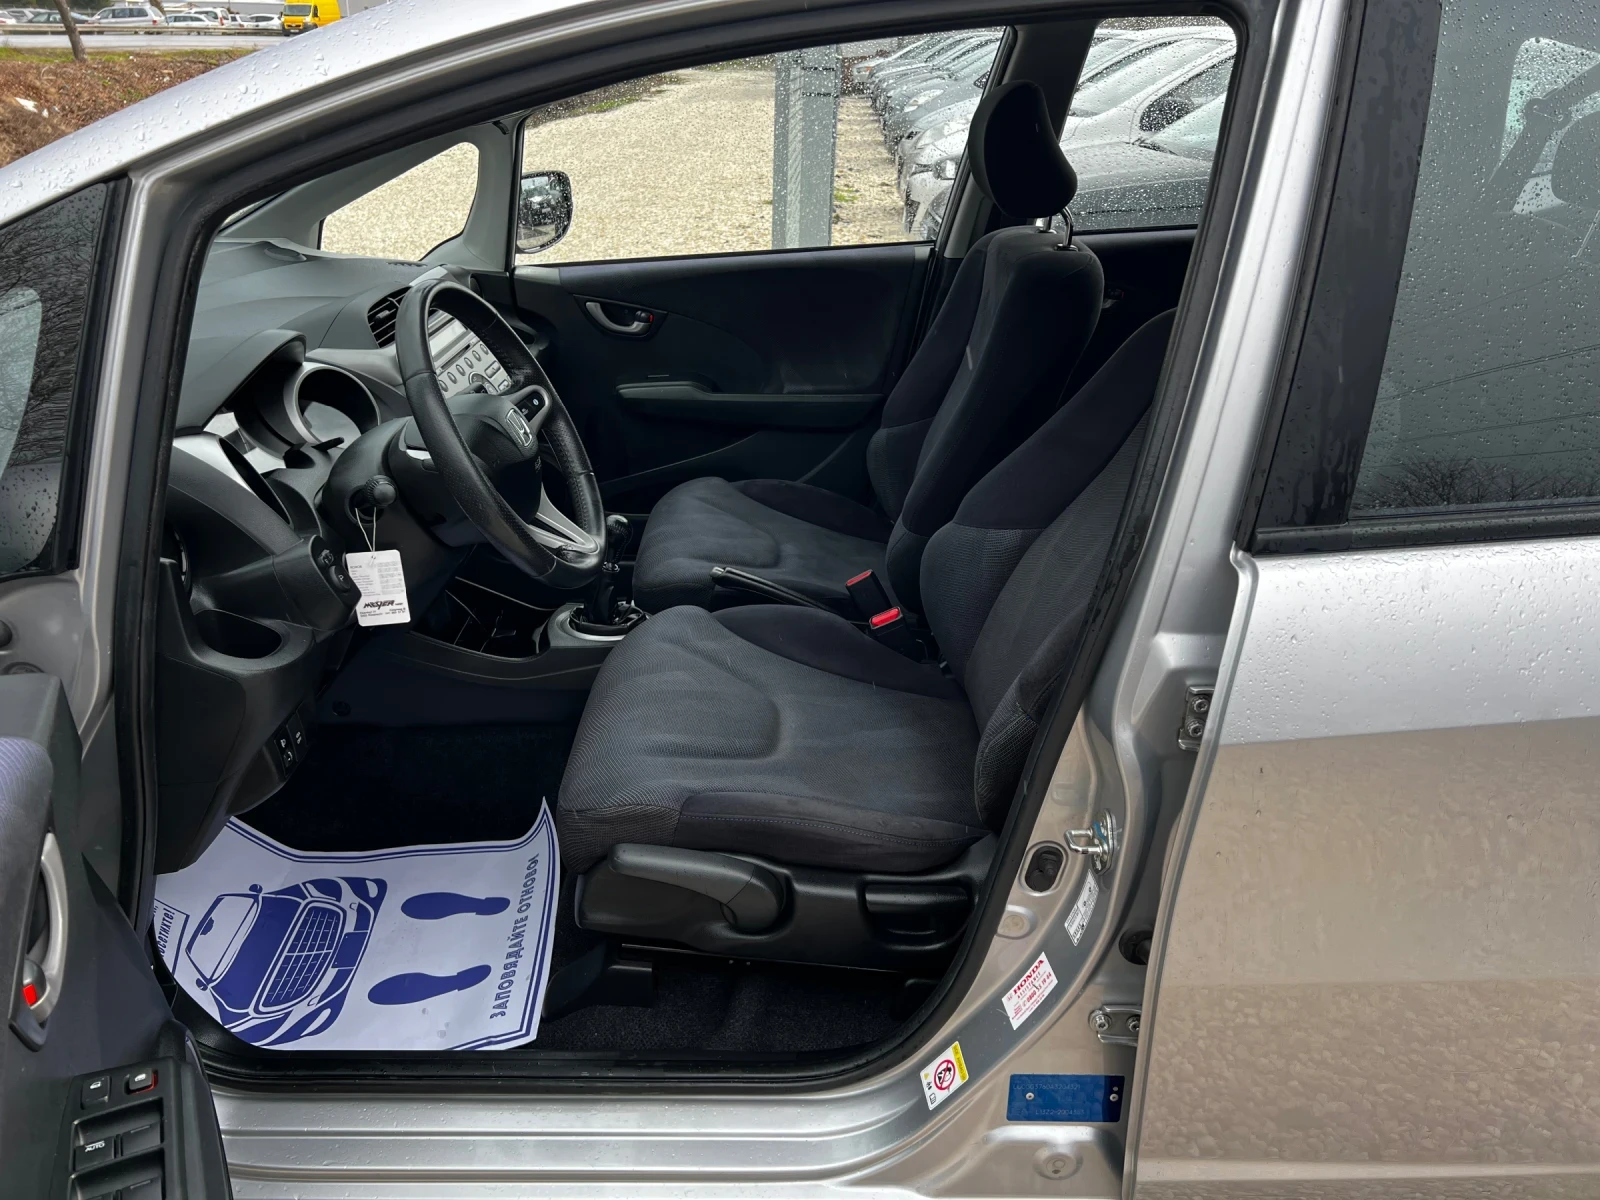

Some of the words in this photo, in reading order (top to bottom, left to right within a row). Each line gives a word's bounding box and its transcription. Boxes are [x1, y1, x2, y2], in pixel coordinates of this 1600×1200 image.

[490, 915, 528, 1019] ЗАПОВЯДАЙТЕ
[517, 853, 539, 914] ОТНОВО!
[1013, 960, 1044, 995] HONDA
[84, 1141, 105, 1152] AUTO
